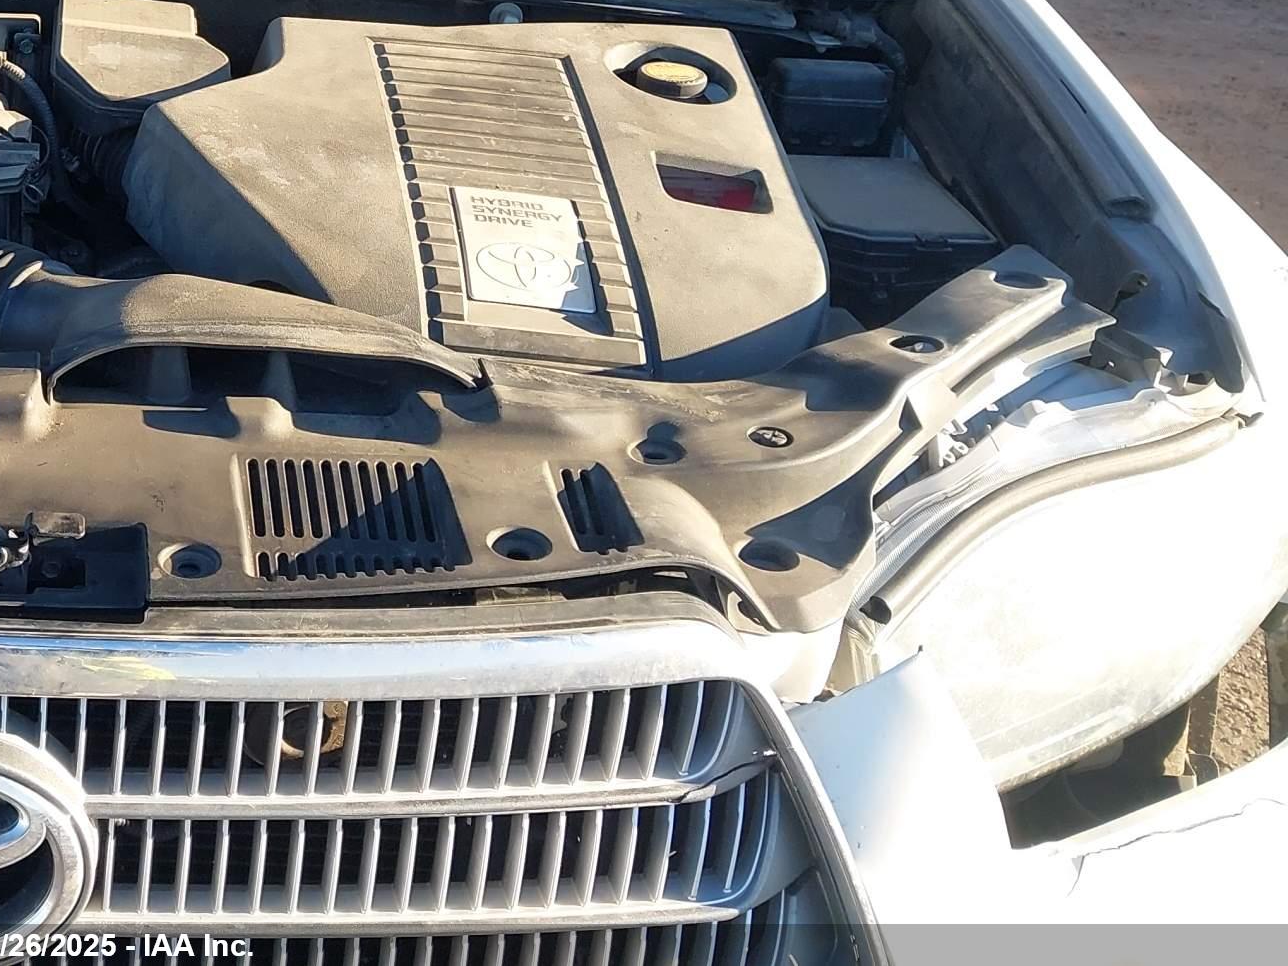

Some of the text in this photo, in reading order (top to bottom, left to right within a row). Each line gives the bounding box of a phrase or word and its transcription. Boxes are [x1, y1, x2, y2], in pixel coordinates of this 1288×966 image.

[470, 196, 544, 211] HYBRID
[471, 204, 563, 222] SYNERGY
[473, 214, 534, 228] DRIVE
